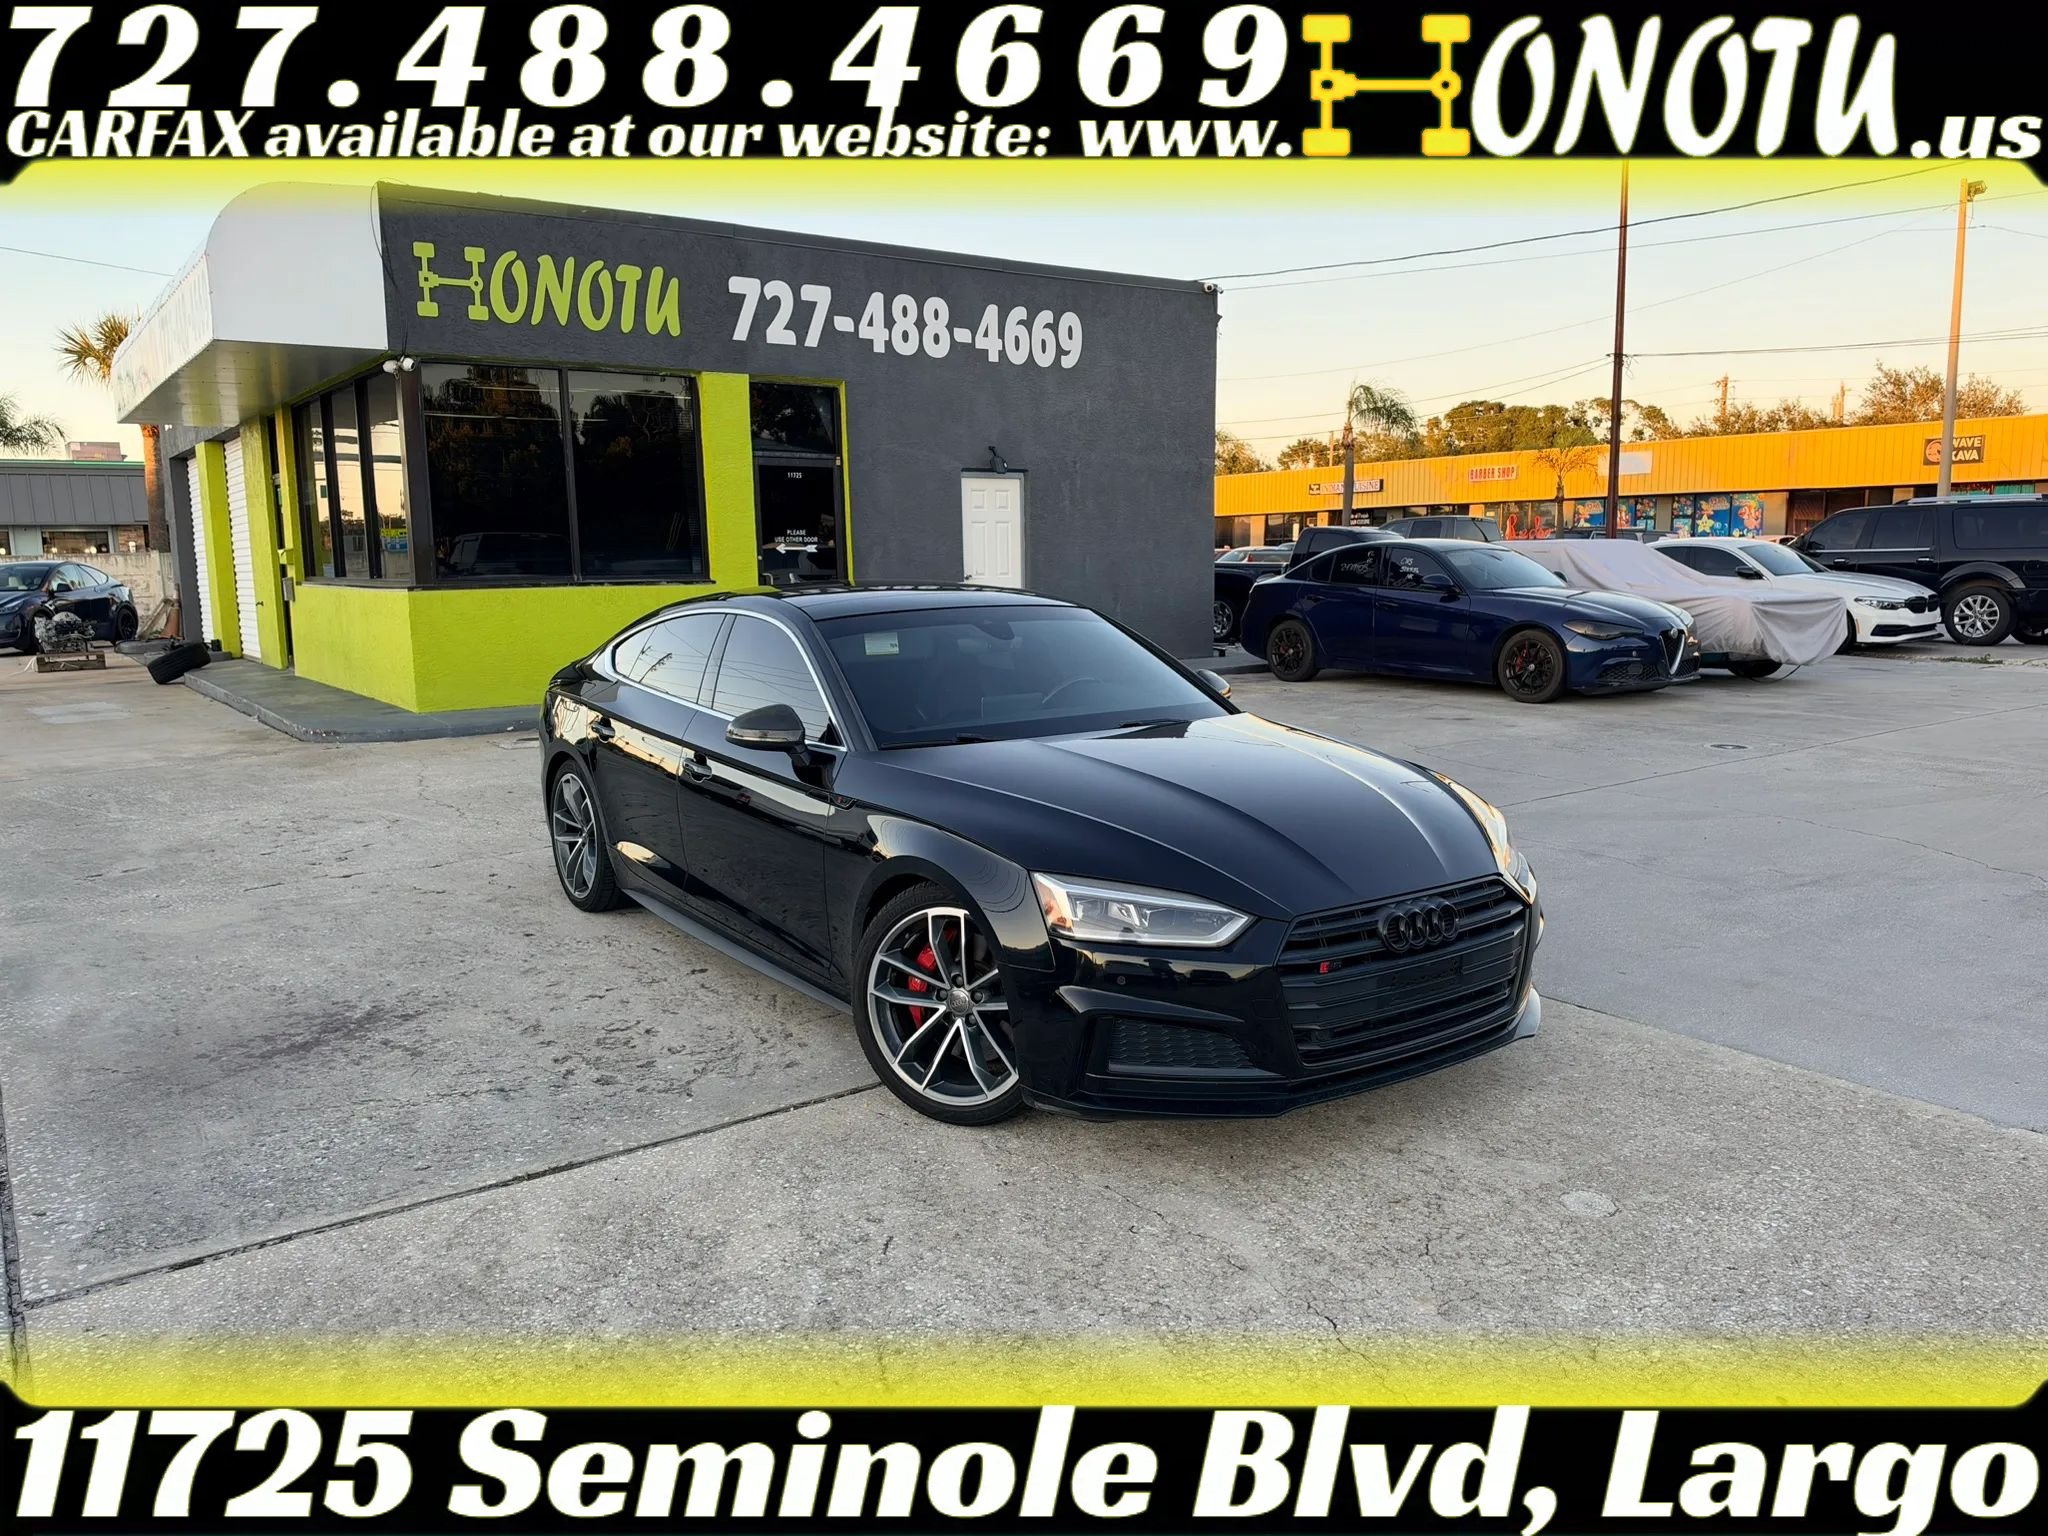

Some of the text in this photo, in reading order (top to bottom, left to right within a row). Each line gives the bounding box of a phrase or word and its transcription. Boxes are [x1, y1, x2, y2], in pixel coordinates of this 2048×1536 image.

[412, 241, 1083, 369] HONOTU 727-488-4669
[1952, 449, 1979, 461] KAVA
[1470, 466, 1514, 480] BARBER SHOP
[1350, 480, 1379, 492] UISINE
